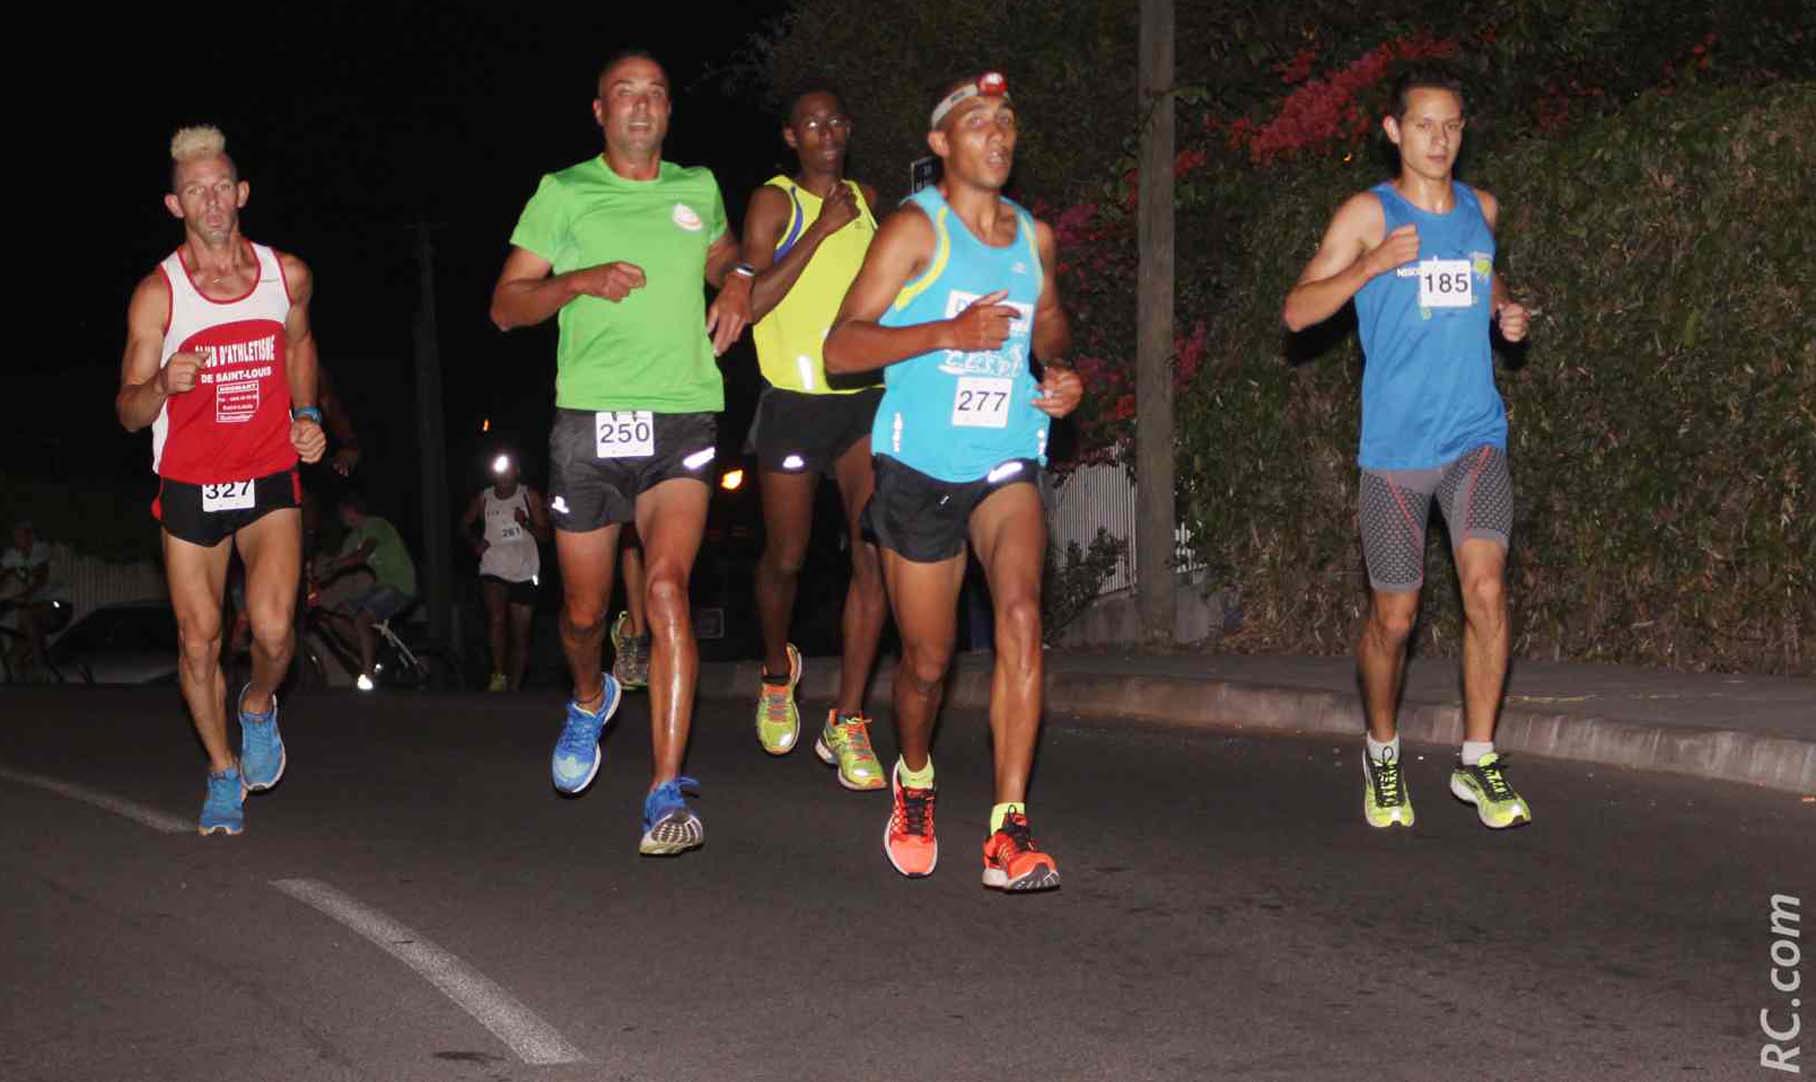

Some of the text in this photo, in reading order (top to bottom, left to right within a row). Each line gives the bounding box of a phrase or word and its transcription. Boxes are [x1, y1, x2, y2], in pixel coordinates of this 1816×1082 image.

[1424, 272, 1469, 293] 185
[201, 366, 272, 384] DE SAINT-LOUIS
[958, 390, 1007, 411] 277
[600, 422, 650, 443] 250
[205, 481, 251, 500] 327
